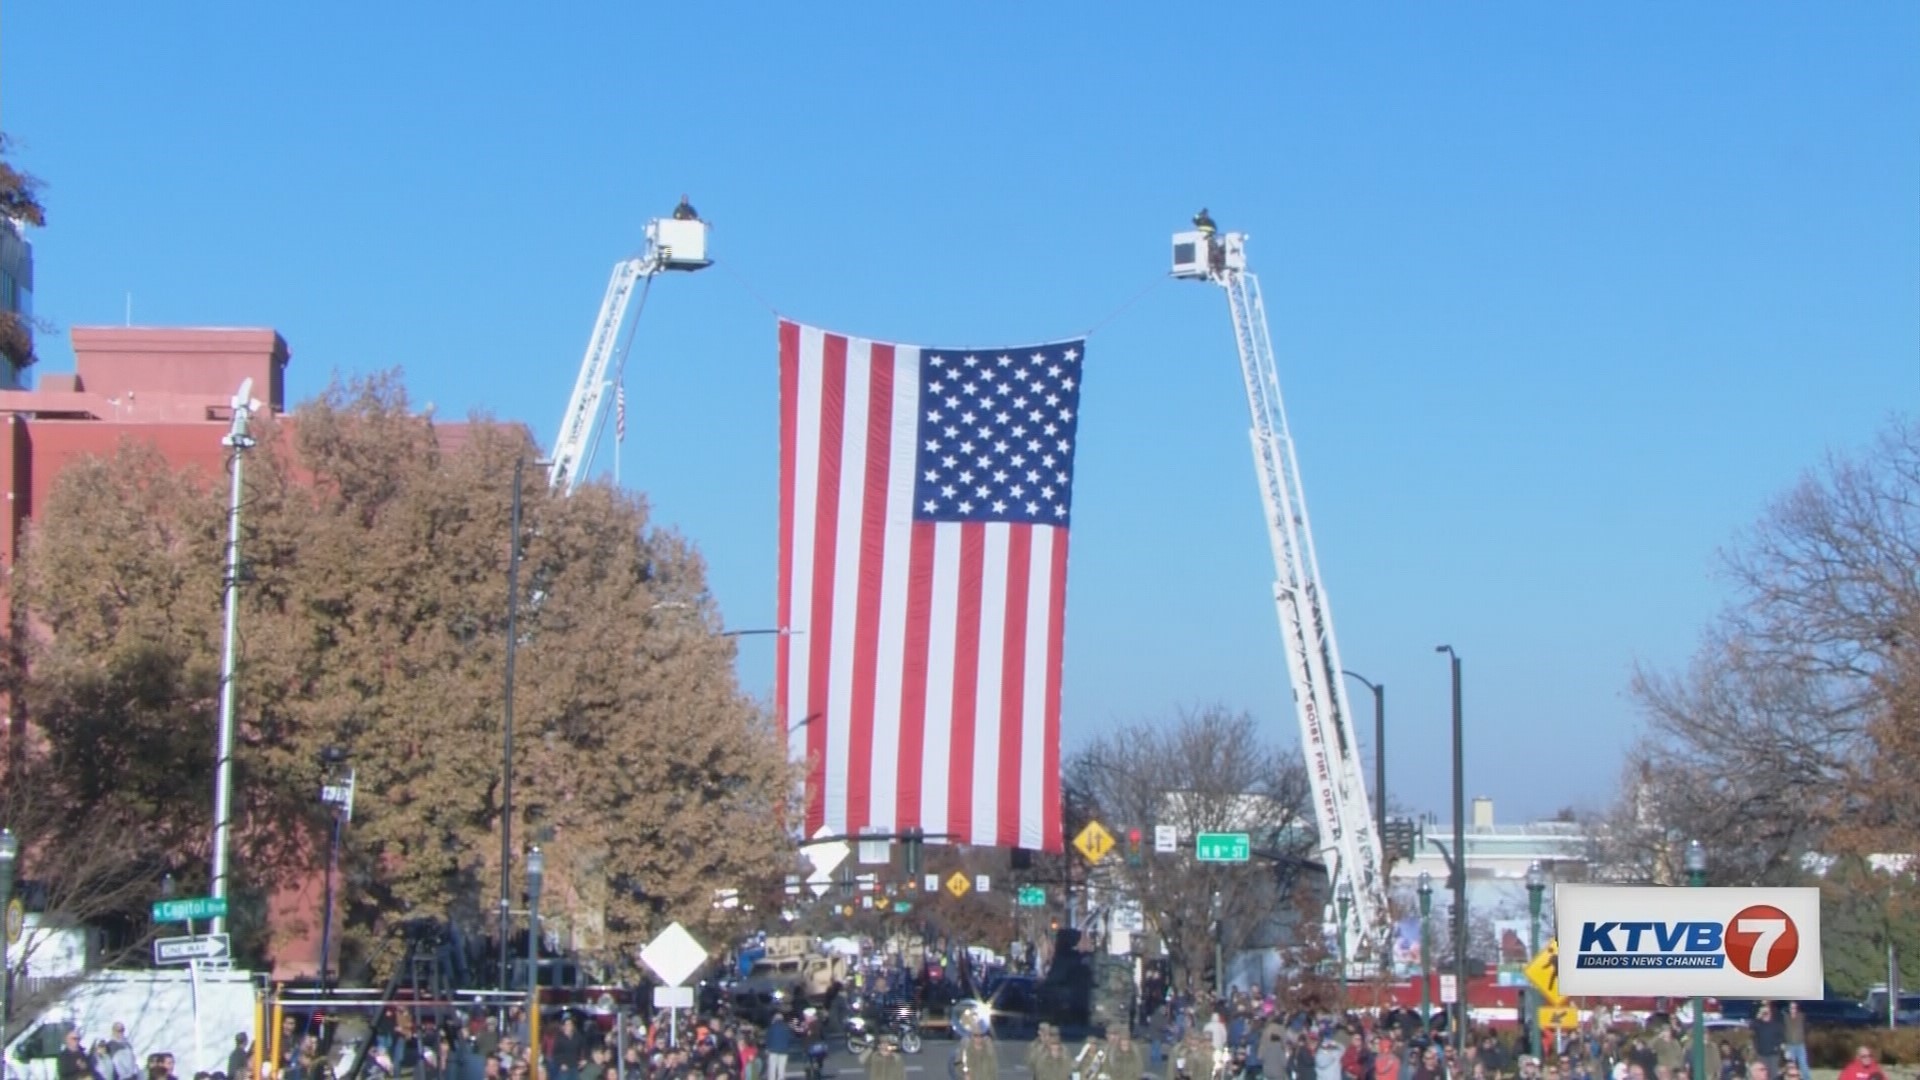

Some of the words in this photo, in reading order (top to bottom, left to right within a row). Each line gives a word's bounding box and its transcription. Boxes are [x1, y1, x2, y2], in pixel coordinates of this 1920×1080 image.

[1305, 703, 1321, 745] BOISE
[1315, 752, 1328, 780] FIRE
[163, 901, 205, 918] Capitol
